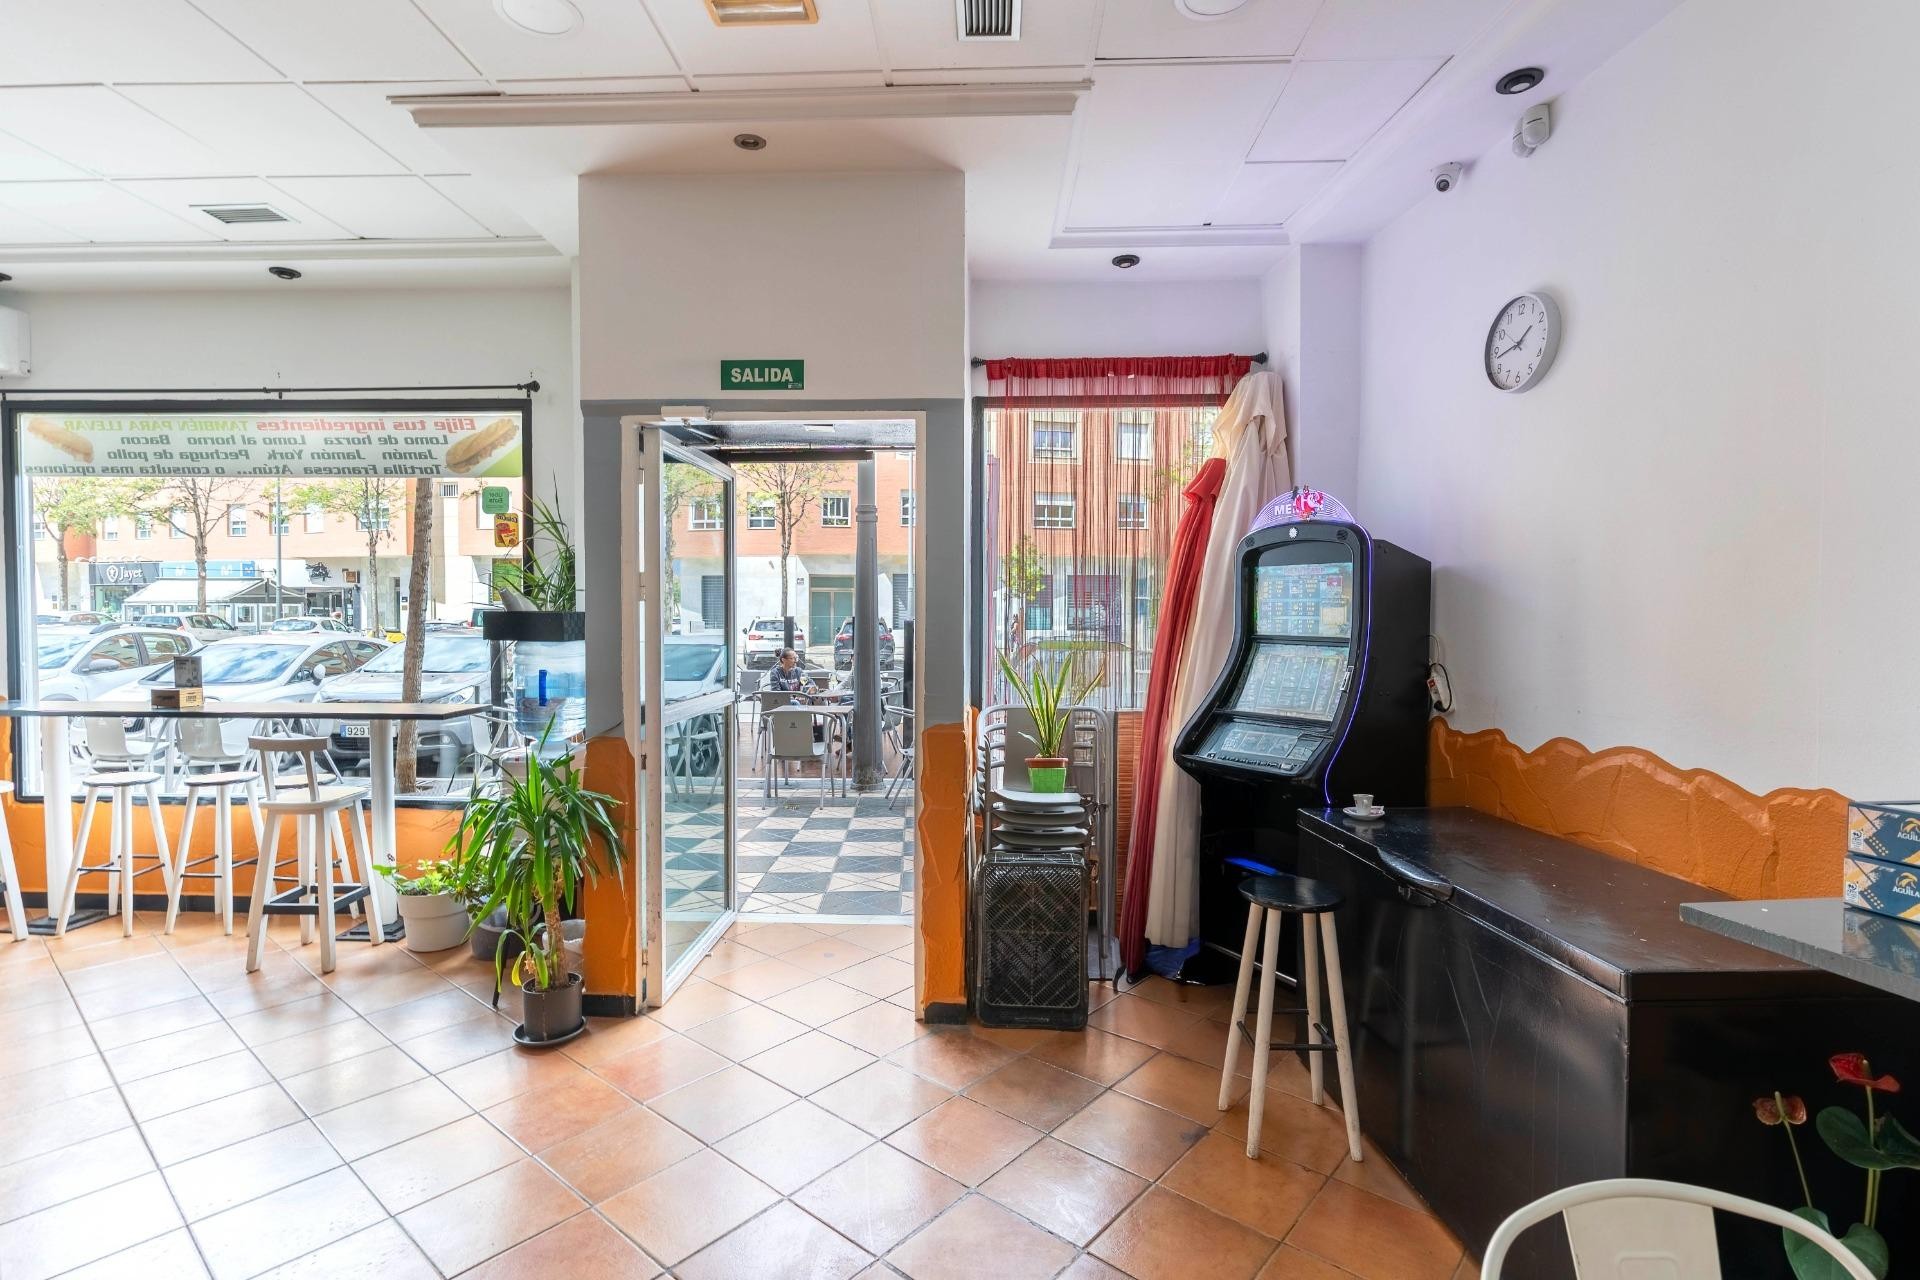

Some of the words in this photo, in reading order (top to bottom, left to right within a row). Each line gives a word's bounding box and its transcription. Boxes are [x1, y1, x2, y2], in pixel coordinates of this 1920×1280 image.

[1518, 303, 1526, 316] 12
[1531, 303, 1535, 315] 1
[1506, 313, 1513, 325] 11
[1538, 311, 1545, 324] 2
[1498, 329, 1506, 342] 10
[1494, 346, 1500, 358] 9
[731, 367, 794, 383] SALIDA
[1527, 362, 1533, 375] 5
[1505, 369, 1511, 383] 7
[1514, 371, 1521, 384] 6
